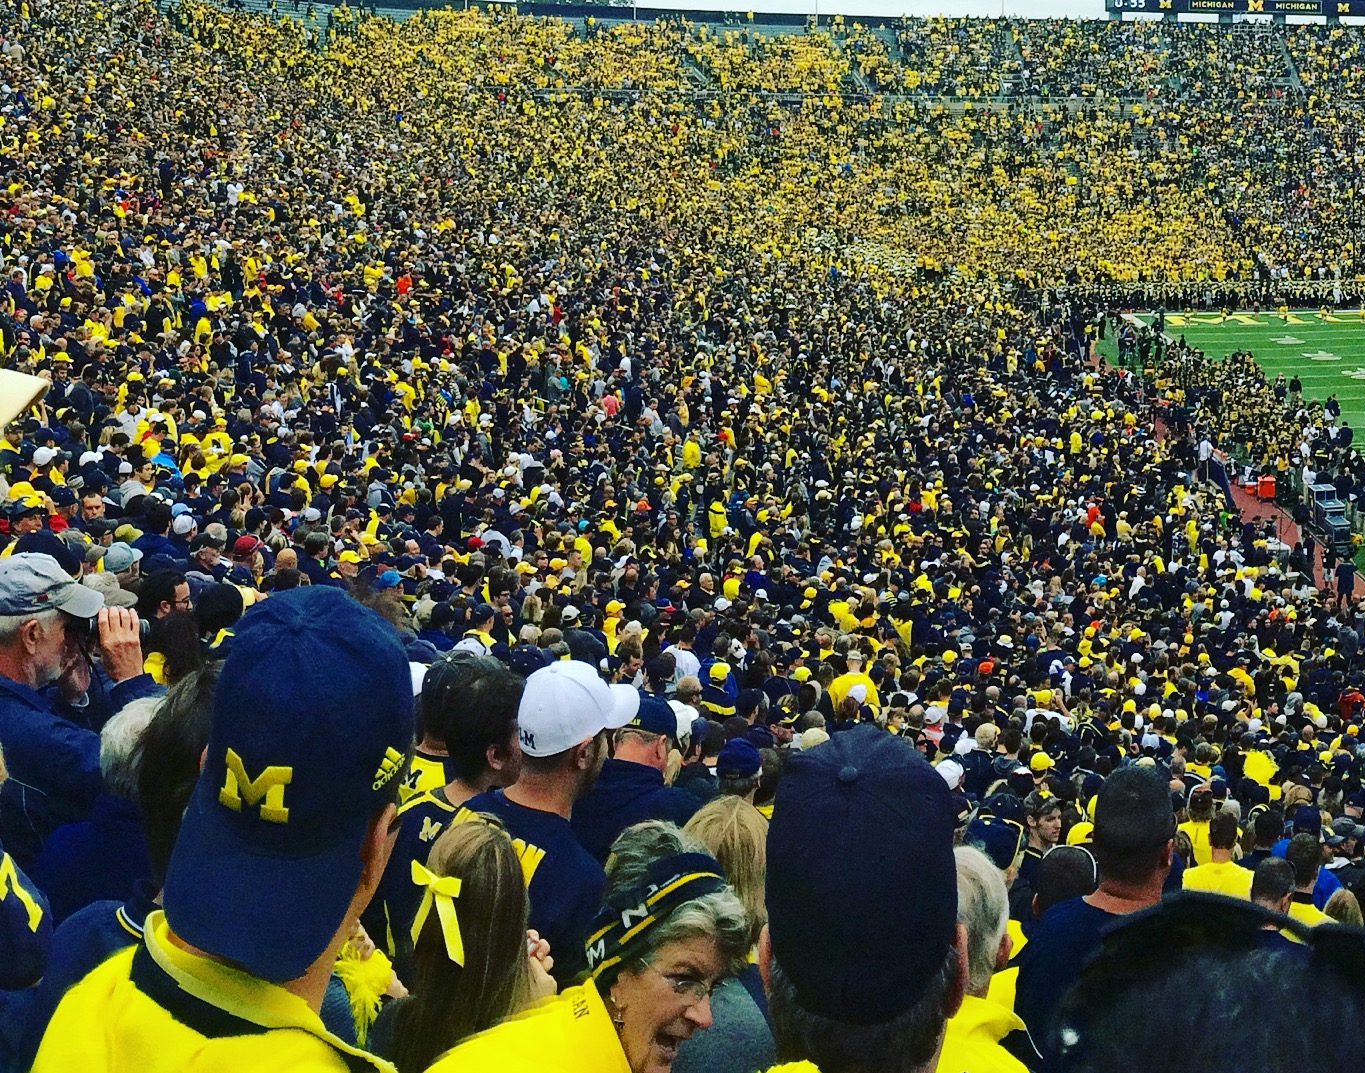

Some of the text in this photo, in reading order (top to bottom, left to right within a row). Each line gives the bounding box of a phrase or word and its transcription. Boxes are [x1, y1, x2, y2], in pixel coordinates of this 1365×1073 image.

[1158, 0, 1172, 9] M
[1191, 1, 1234, 9] MICHIGAN
[1247, 0, 1264, 11] M
[1275, 2, 1318, 10] MICHIGAN
[1337, 2, 1350, 13] M
[218, 747, 293, 823] M
[419, 815, 443, 842] M
